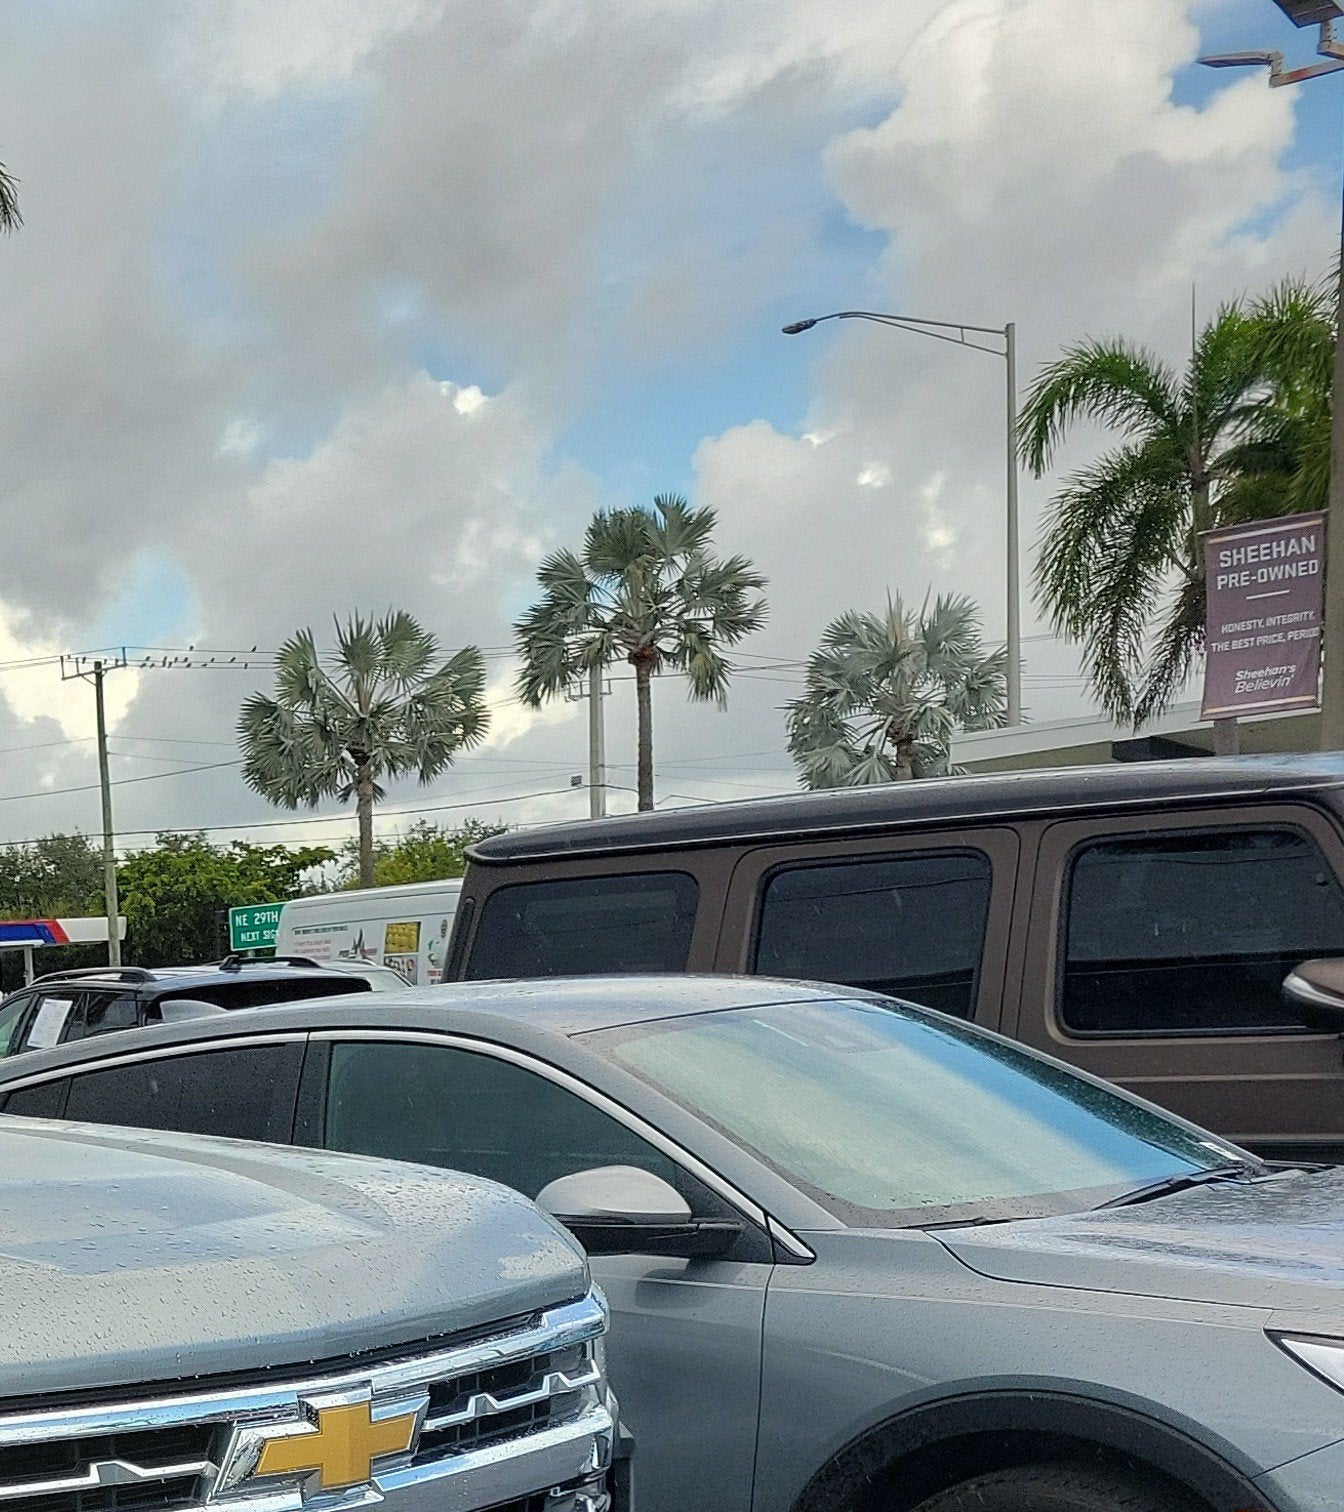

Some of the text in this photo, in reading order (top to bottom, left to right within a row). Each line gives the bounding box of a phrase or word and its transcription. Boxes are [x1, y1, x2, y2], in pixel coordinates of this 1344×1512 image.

[1219, 535, 1316, 568] SHEEHAN
[1216, 559, 1319, 590] PRE-OWNED
[1211, 641, 1231, 653] THE
[1231, 637, 1255, 650] BEST
[235, 910, 279, 927] NE 29TH
